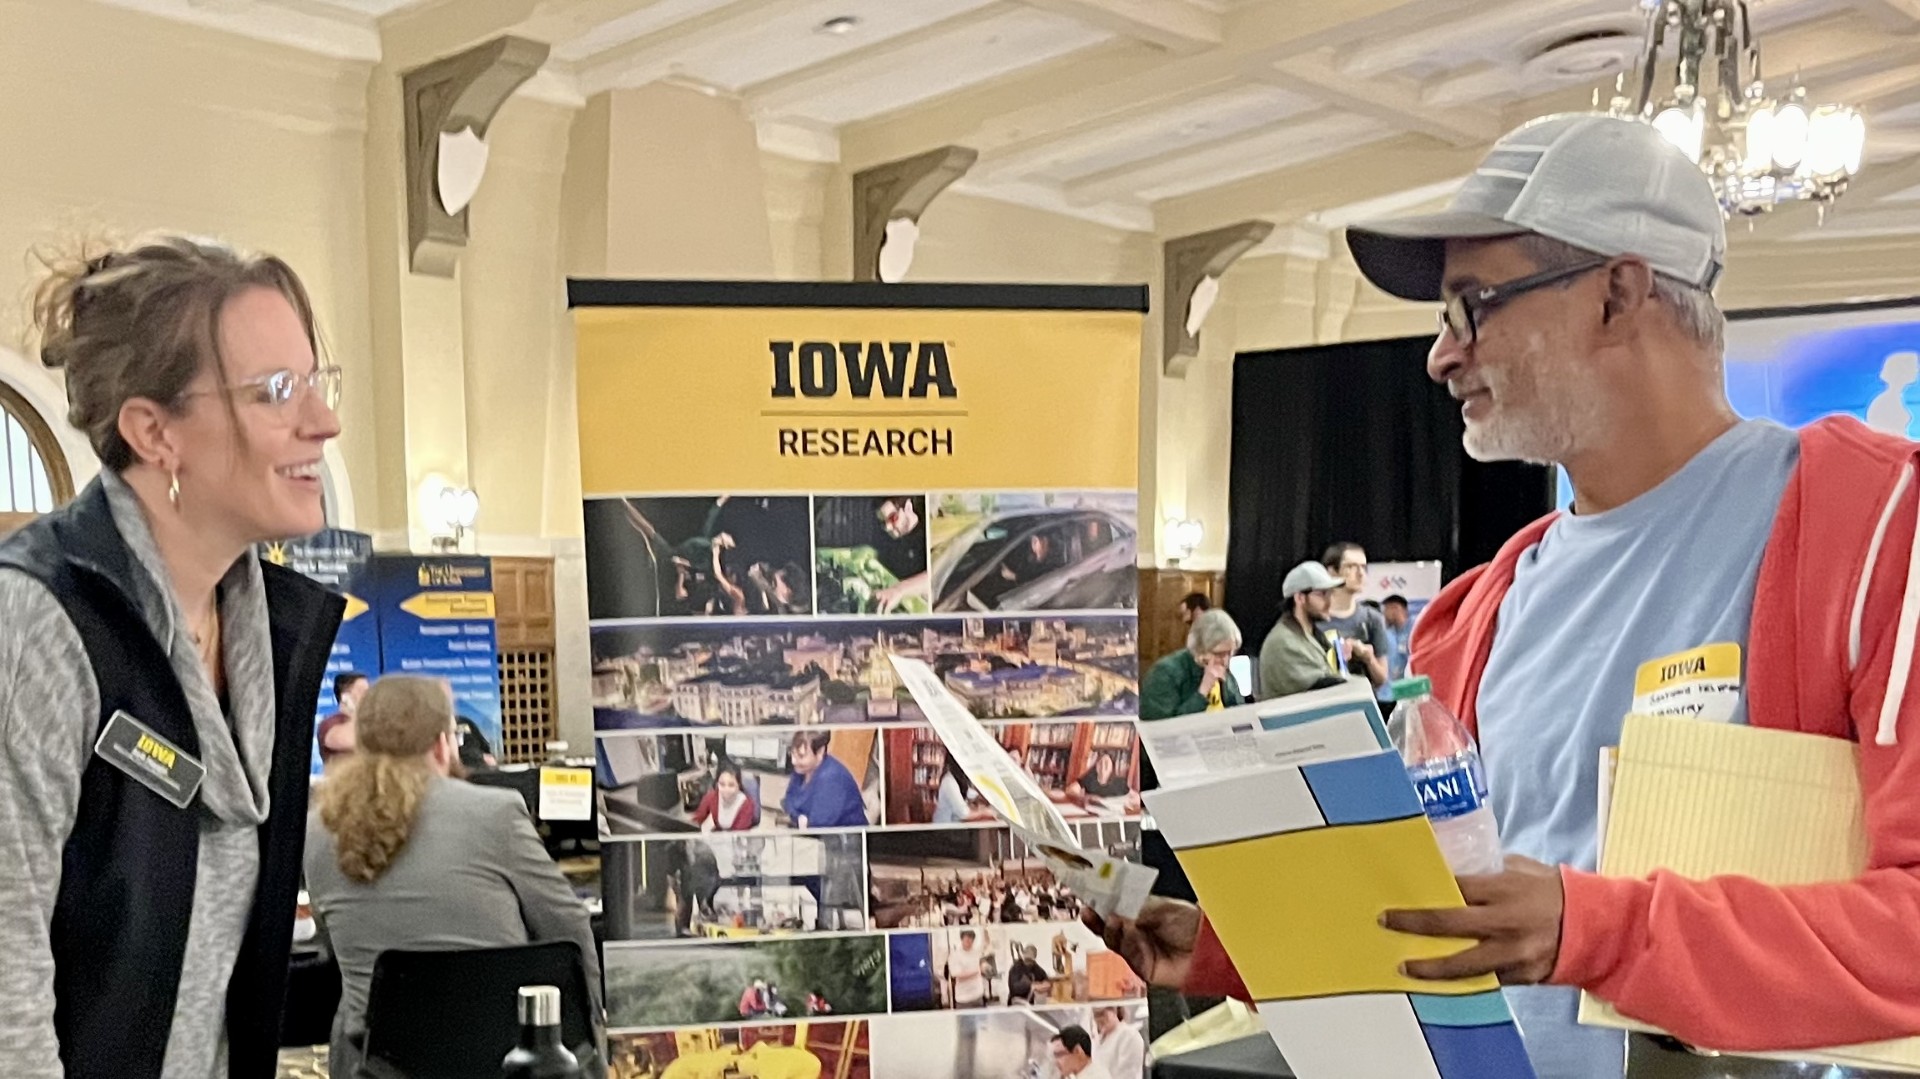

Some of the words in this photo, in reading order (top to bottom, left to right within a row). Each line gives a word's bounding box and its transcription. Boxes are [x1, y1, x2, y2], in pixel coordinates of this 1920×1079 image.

[769, 341, 957, 398] IOWA
[778, 428, 953, 456] RESEARCH
[1660, 656, 1706, 683] IOWA
[137, 732, 176, 770] IOWA
[1413, 776, 1460, 806] ANI
